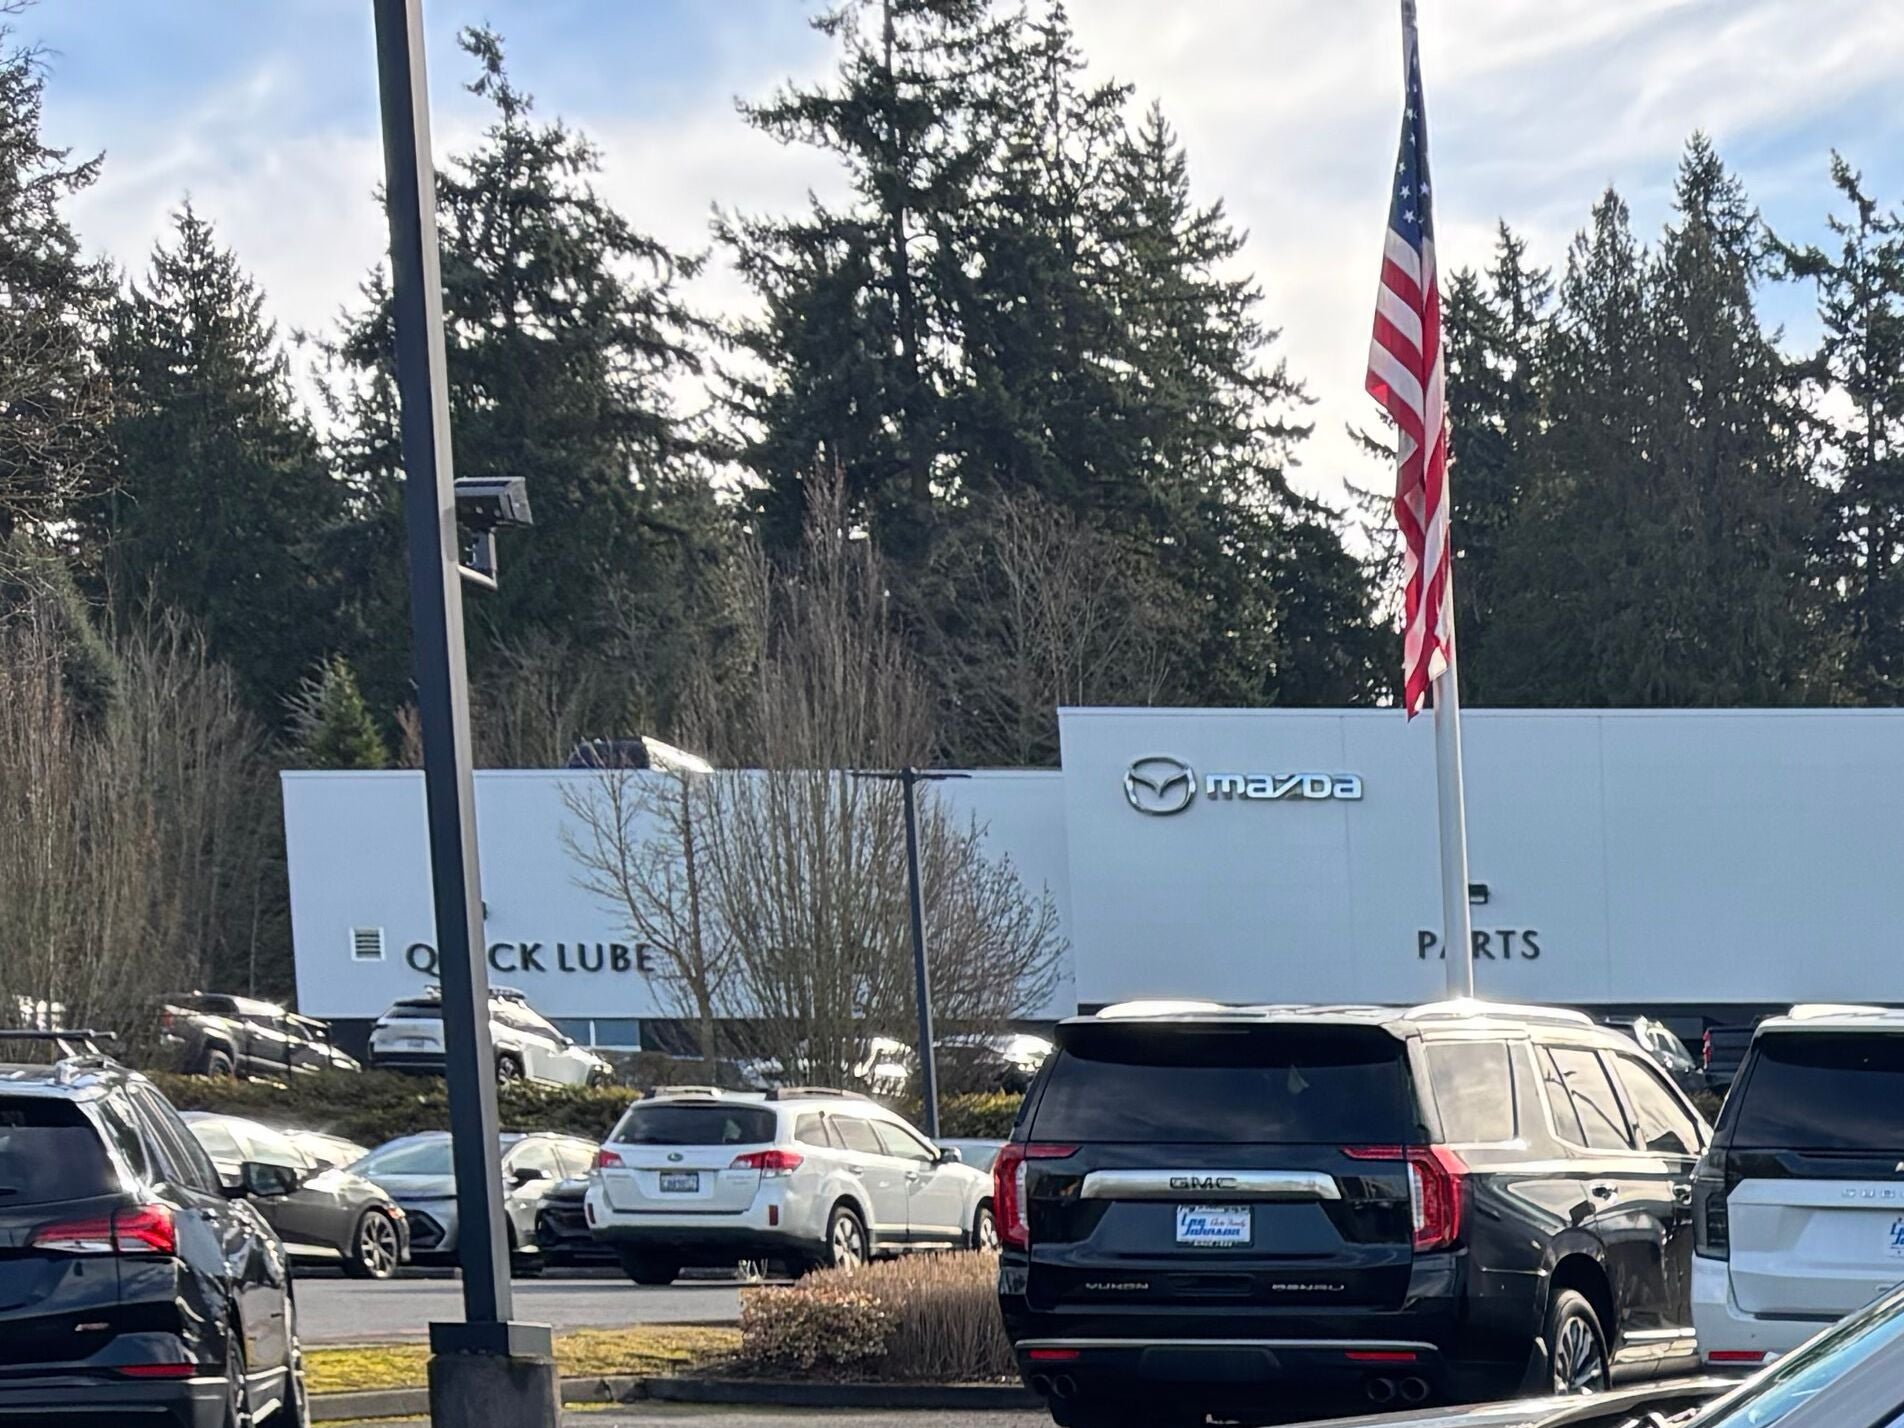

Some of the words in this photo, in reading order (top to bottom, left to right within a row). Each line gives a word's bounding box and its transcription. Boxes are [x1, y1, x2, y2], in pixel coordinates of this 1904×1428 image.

[405, 942, 546, 978] QCK
[556, 942, 656, 973] LUBE
[1417, 929, 1541, 960] PRTS
[1169, 1176, 1238, 1190] GMC
